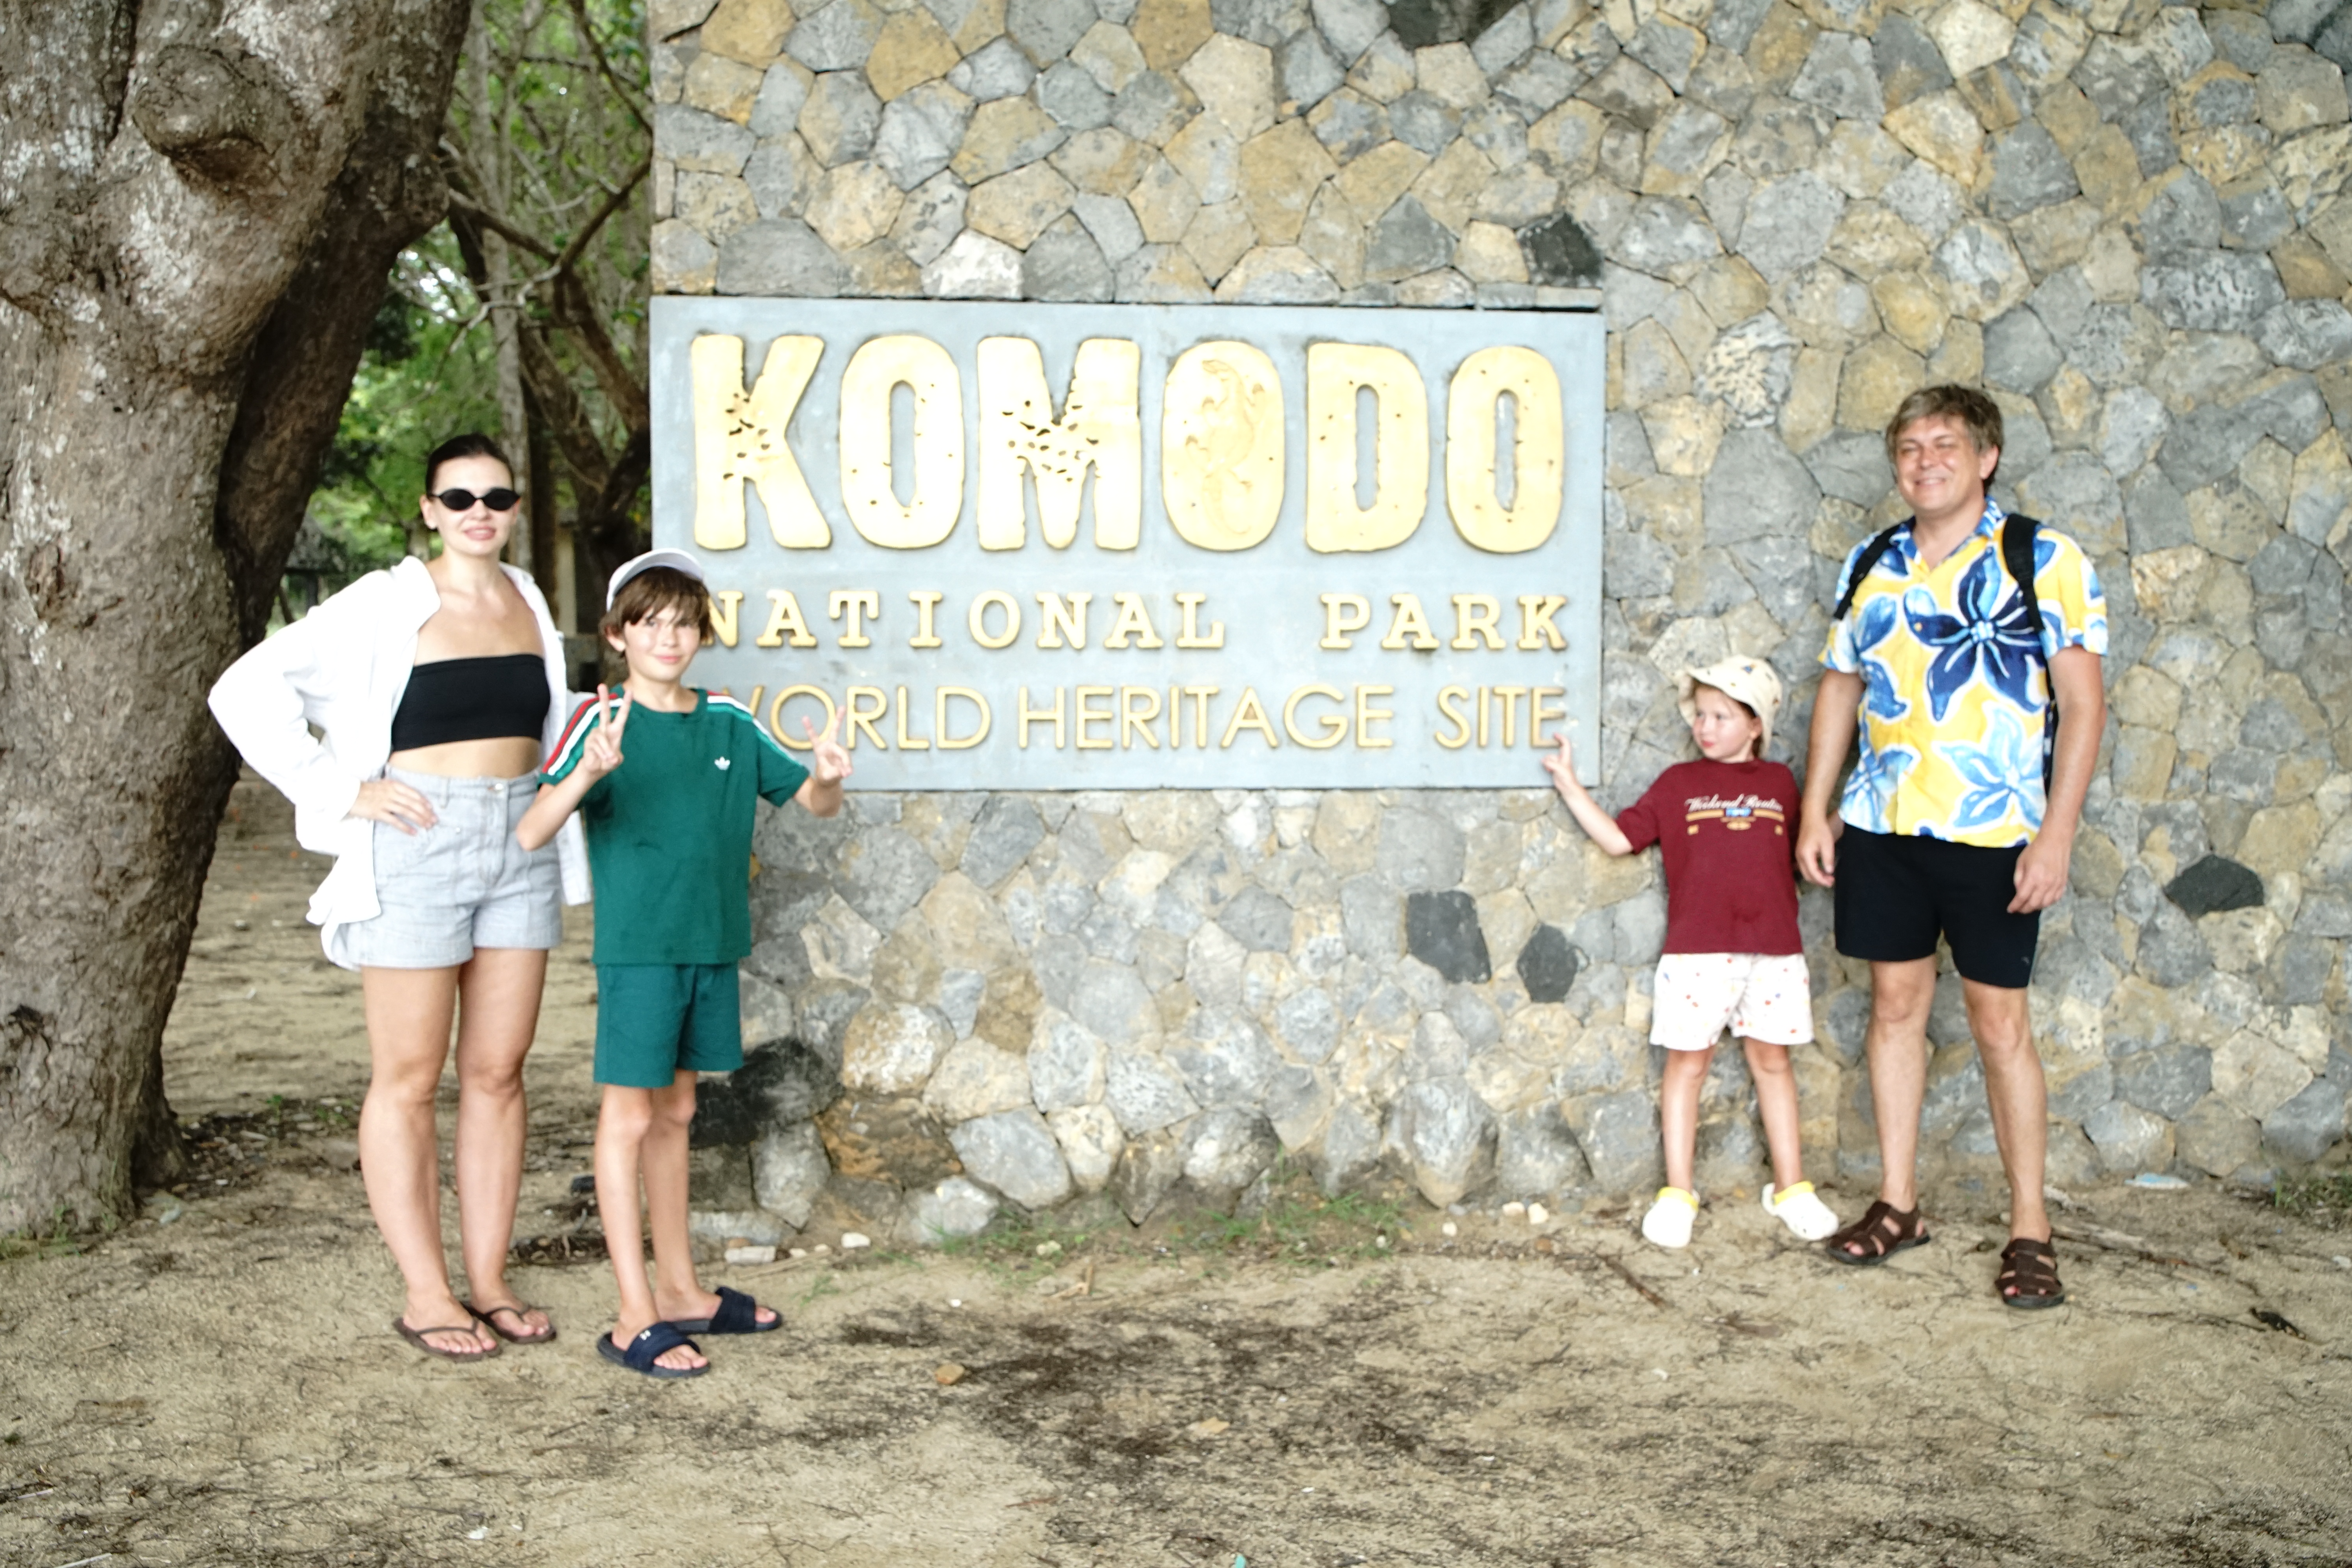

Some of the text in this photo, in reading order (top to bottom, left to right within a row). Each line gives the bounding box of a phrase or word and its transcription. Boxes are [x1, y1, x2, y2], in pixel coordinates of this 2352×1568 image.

[691, 334, 1563, 553] KOMODO
[1320, 593, 1568, 650] PARK
[720, 685, 1566, 751] ORLD HERITAGE SITE
